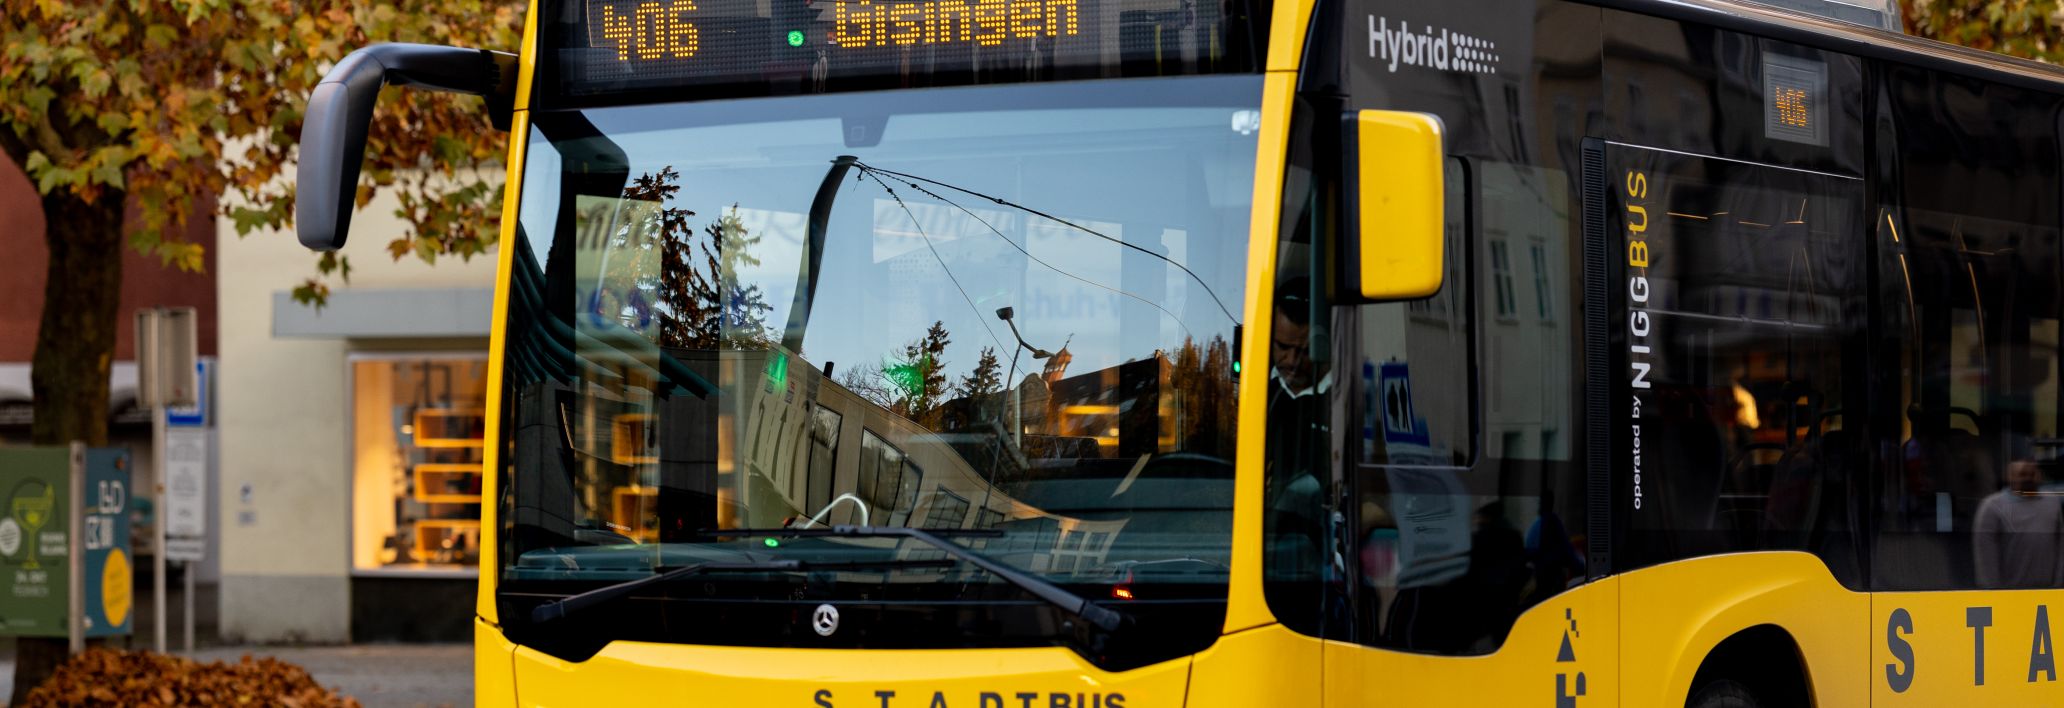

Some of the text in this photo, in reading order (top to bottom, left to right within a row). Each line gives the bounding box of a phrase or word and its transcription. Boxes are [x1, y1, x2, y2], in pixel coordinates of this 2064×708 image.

[604, 0, 699, 60] 406
[836, 0, 1078, 47] Gisingen
[1368, 14, 1449, 73] Hybrid
[1775, 86, 1808, 127] 406
[1627, 171, 1651, 510] operated by NIGGBUS
